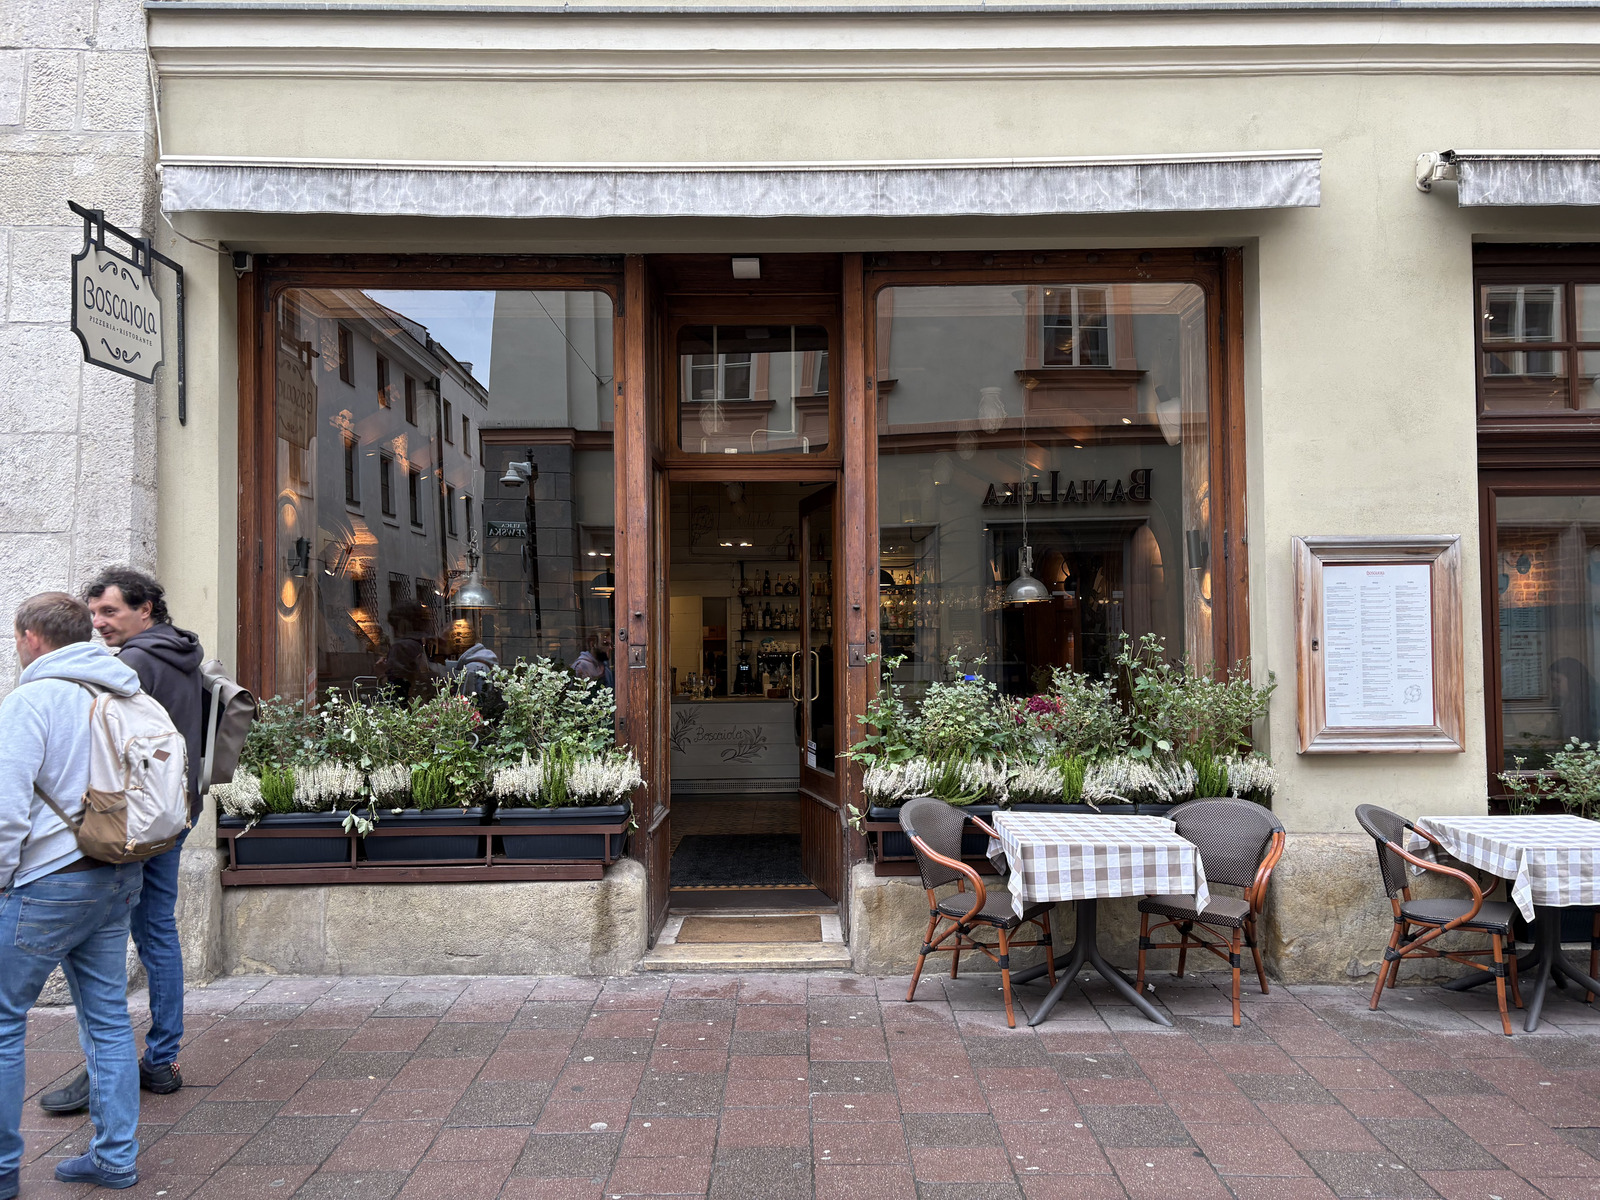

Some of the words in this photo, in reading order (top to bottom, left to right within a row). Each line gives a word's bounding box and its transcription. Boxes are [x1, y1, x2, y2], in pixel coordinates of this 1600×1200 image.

[89, 315, 116, 332] PIZZERIA
[119, 328, 153, 347] RISTORANTE
[694, 725, 744, 743] Boscaiola
